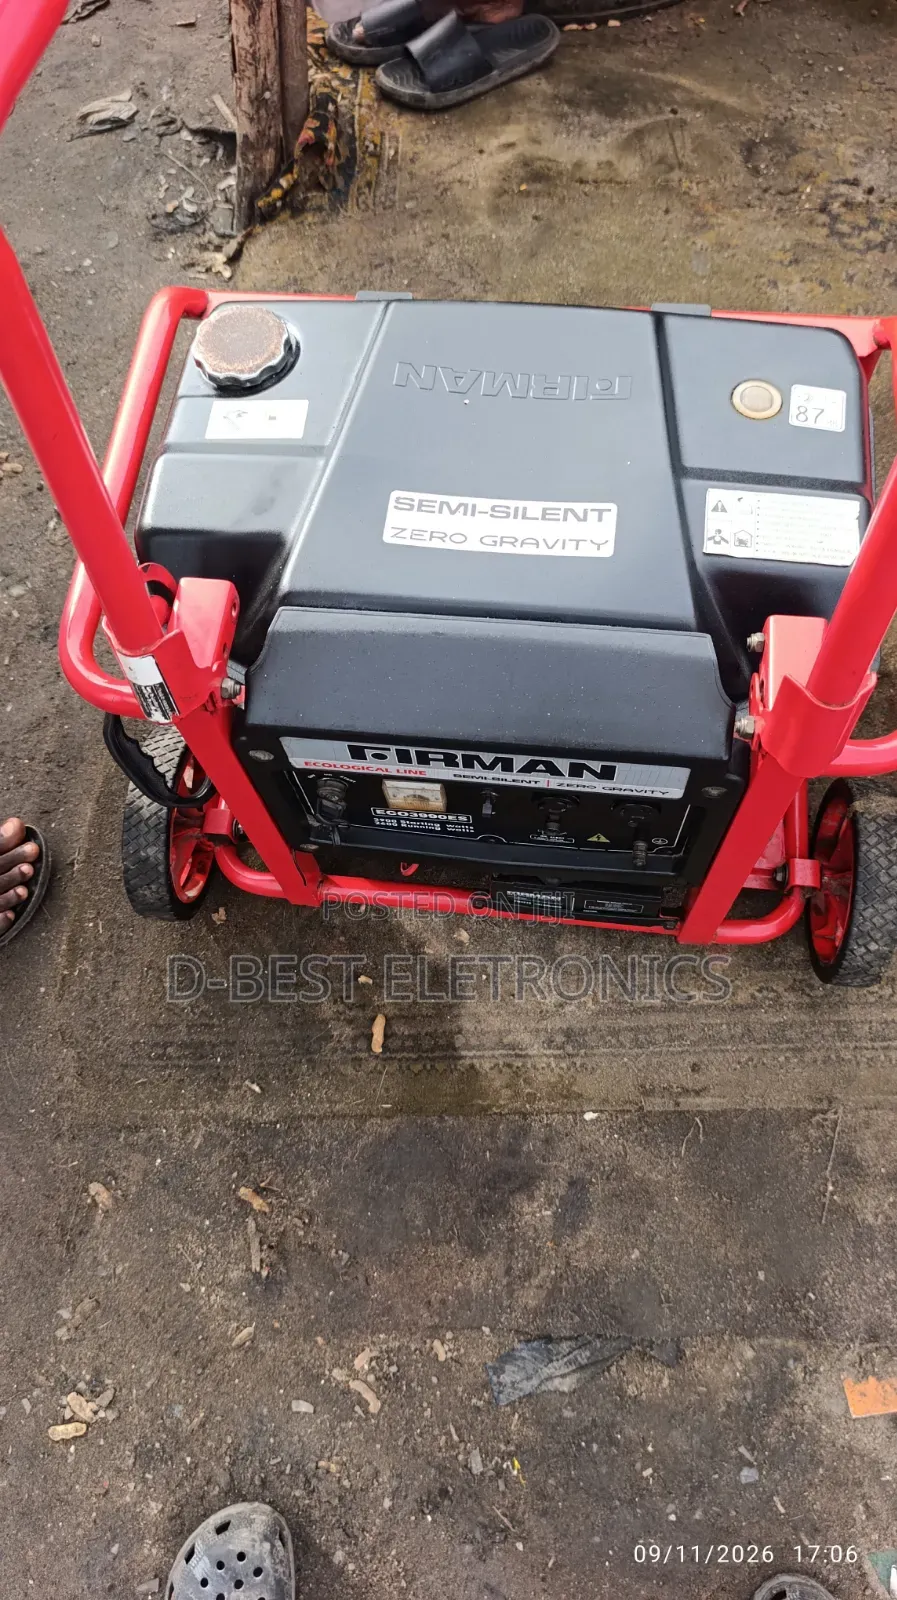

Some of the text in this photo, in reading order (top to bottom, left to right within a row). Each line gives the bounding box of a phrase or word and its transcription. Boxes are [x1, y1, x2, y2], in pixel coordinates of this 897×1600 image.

[392, 361, 633, 401] FIRMAN
[795, 405, 825, 425] 87
[393, 495, 611, 522] SEMI-SILENT
[390, 526, 609, 551] ZERO GRAVITY
[304, 761, 427, 776] ECOLOGICAL LINE
[346, 743, 617, 782] FIRMAN
[453, 773, 670, 795] SEMI-SILENT ZERO GRAVITY
